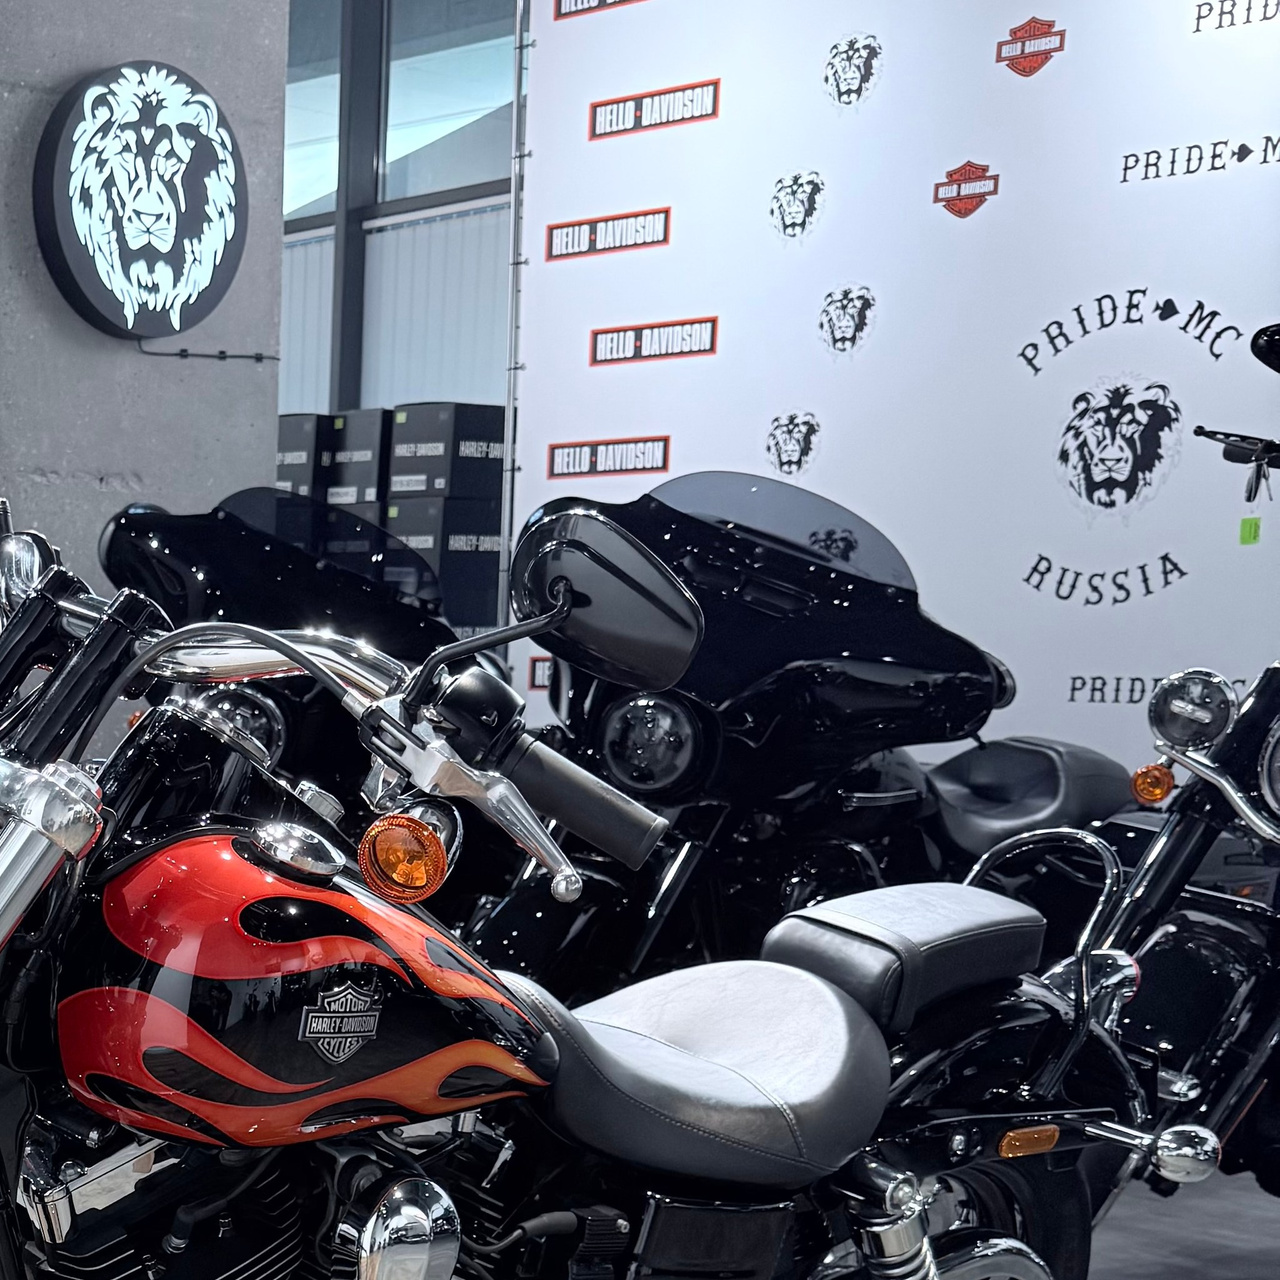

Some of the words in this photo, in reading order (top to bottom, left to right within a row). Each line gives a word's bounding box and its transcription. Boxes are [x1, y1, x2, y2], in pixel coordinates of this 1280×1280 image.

[1192, 0, 1280, 33] PRID
[595, 100, 636, 135] HELLO
[641, 84, 715, 127] DAVIDSON
[1120, 138, 1230, 183] PRIDE
[1259, 135, 1280, 164] M
[551, 224, 590, 257] HELLO
[595, 211, 665, 250] DAVIDSON
[595, 330, 635, 362] HELLO
[640, 320, 713, 357] DAVIDSON
[1017, 286, 1149, 376] PRIDE
[1177, 300, 1244, 361] MC
[553, 445, 591, 475] HELLO
[596, 440, 665, 472] DAVIDSON
[1022, 552, 1189, 606] RUSSIA
[330, 993, 367, 1012] MOTOR
[310, 1016, 376, 1033] HARLEY-DAVIDSON
[323, 1037, 358, 1058] CYCLES
